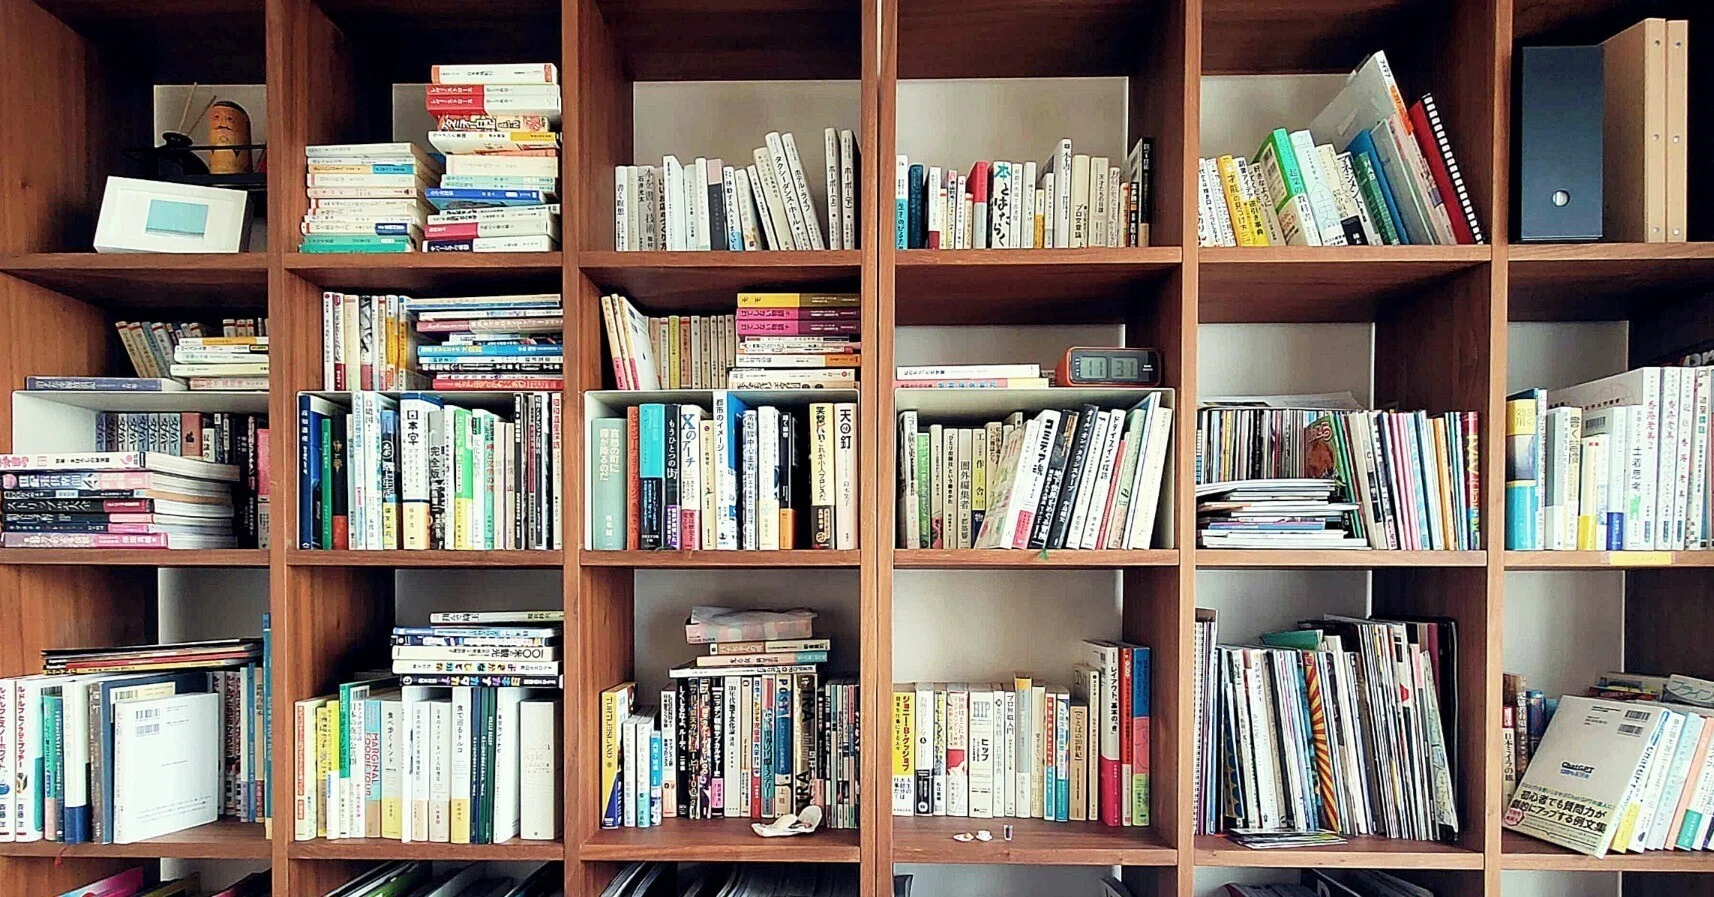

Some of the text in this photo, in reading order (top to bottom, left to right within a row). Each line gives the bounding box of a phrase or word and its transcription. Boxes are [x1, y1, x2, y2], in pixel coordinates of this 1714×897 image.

[645, 168, 655, 234] 本を書く技術
[775, 156, 801, 227] タクシーダンス・ホール
[794, 170, 811, 212] ホテル・ライフ
[993, 162, 1012, 246] 本とはたらく
[1075, 204, 1083, 239] プロ文章論
[741, 323, 785, 331] はてしない物語
[681, 413, 697, 468] Xのアーチ
[716, 399, 725, 453] 都市のイメージ
[839, 409, 852, 449] 天の釘
[430, 446, 440, 479] 完全版
[666, 419, 678, 480] もうひとつの街
[902, 696, 910, 772] ジョニー・B・グッジョブ
[981, 738, 989, 762] ヒップ
[371, 732, 380, 785] MARGINAL
[1561, 761, 1595, 775] ChatGPT
[1511, 798, 1608, 834] 劇的にアップする例文集
[1520, 790, 1607, 821] 初心者でも質問力が
